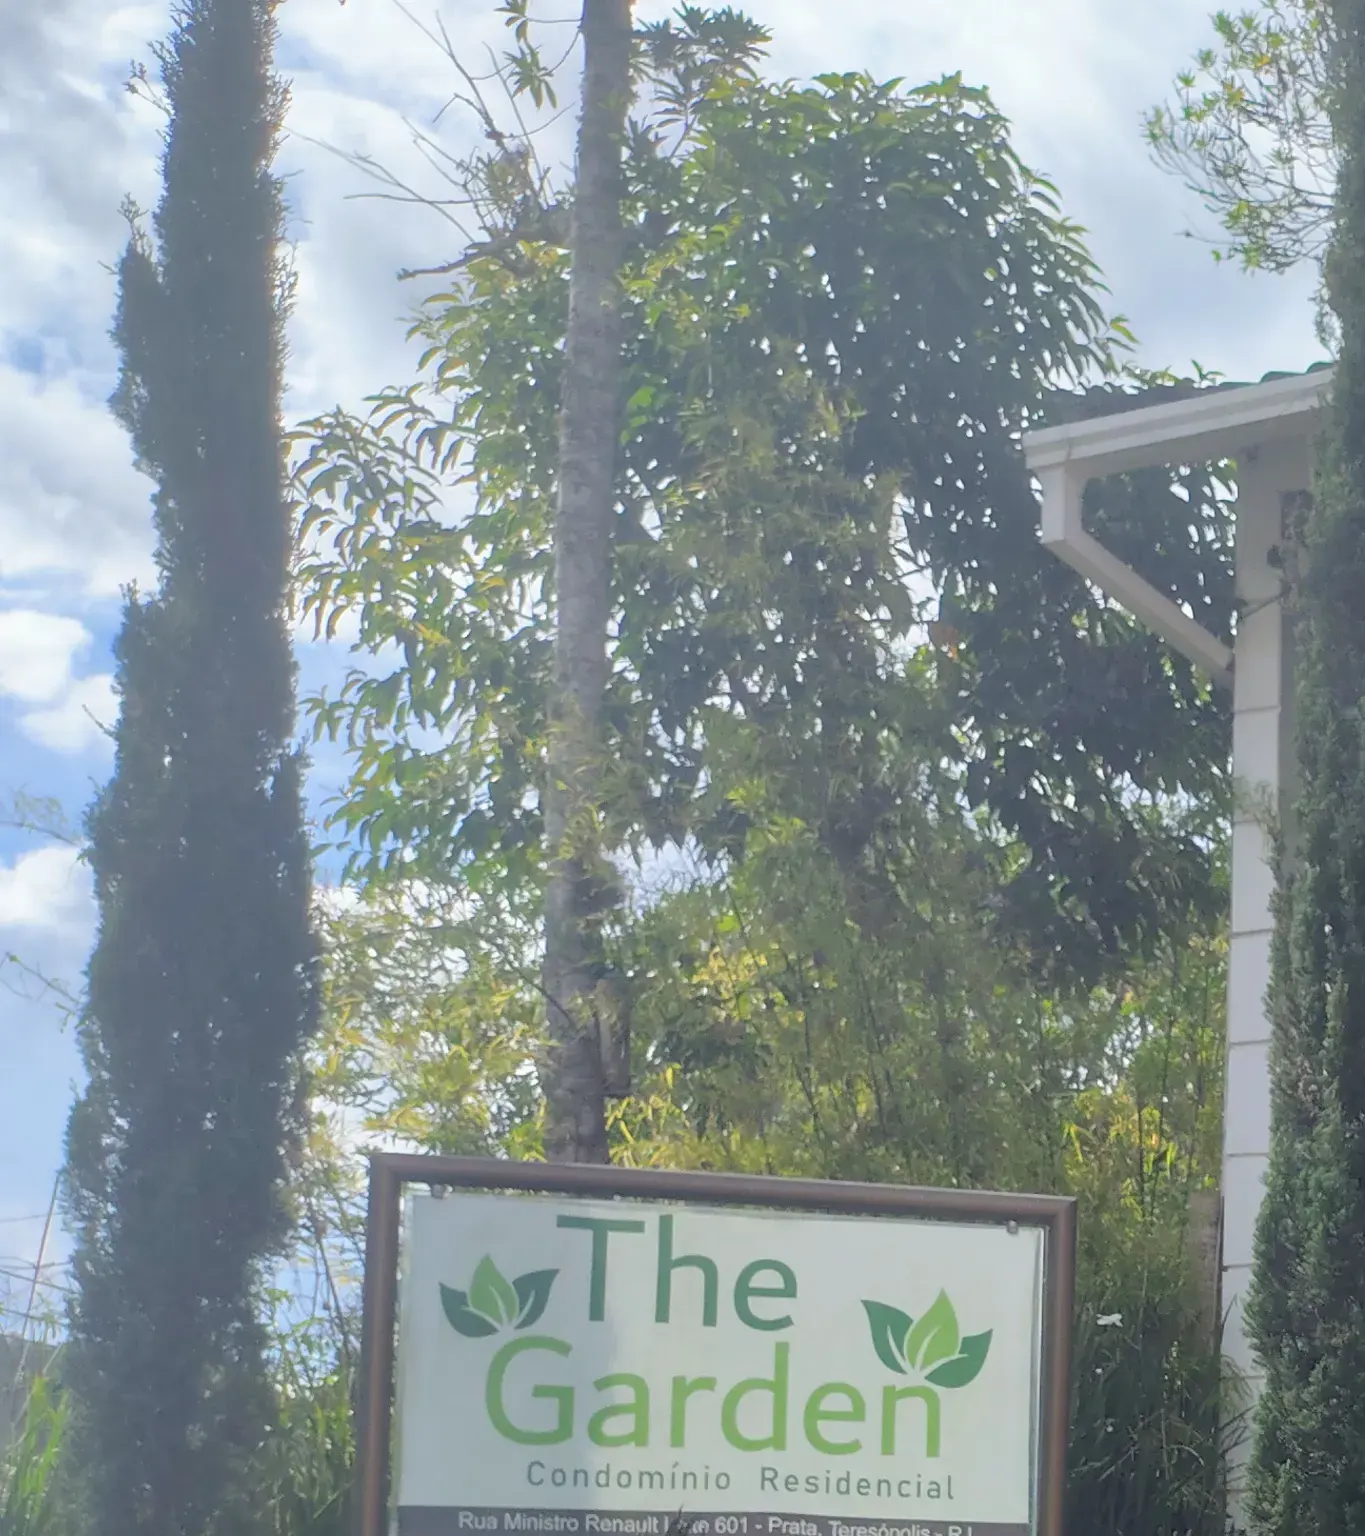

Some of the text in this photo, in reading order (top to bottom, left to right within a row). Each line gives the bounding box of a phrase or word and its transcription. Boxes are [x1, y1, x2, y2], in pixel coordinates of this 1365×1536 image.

[555, 1213, 799, 1332] The
[485, 1336, 941, 1458] Garden
[527, 1461, 954, 1500] Condomínio Residencial
[458, 1511, 498, 1530] Rua
[503, 1512, 579, 1533] Ministro
[585, 1514, 659, 1534] Renault
[714, 1516, 748, 1534] 601
